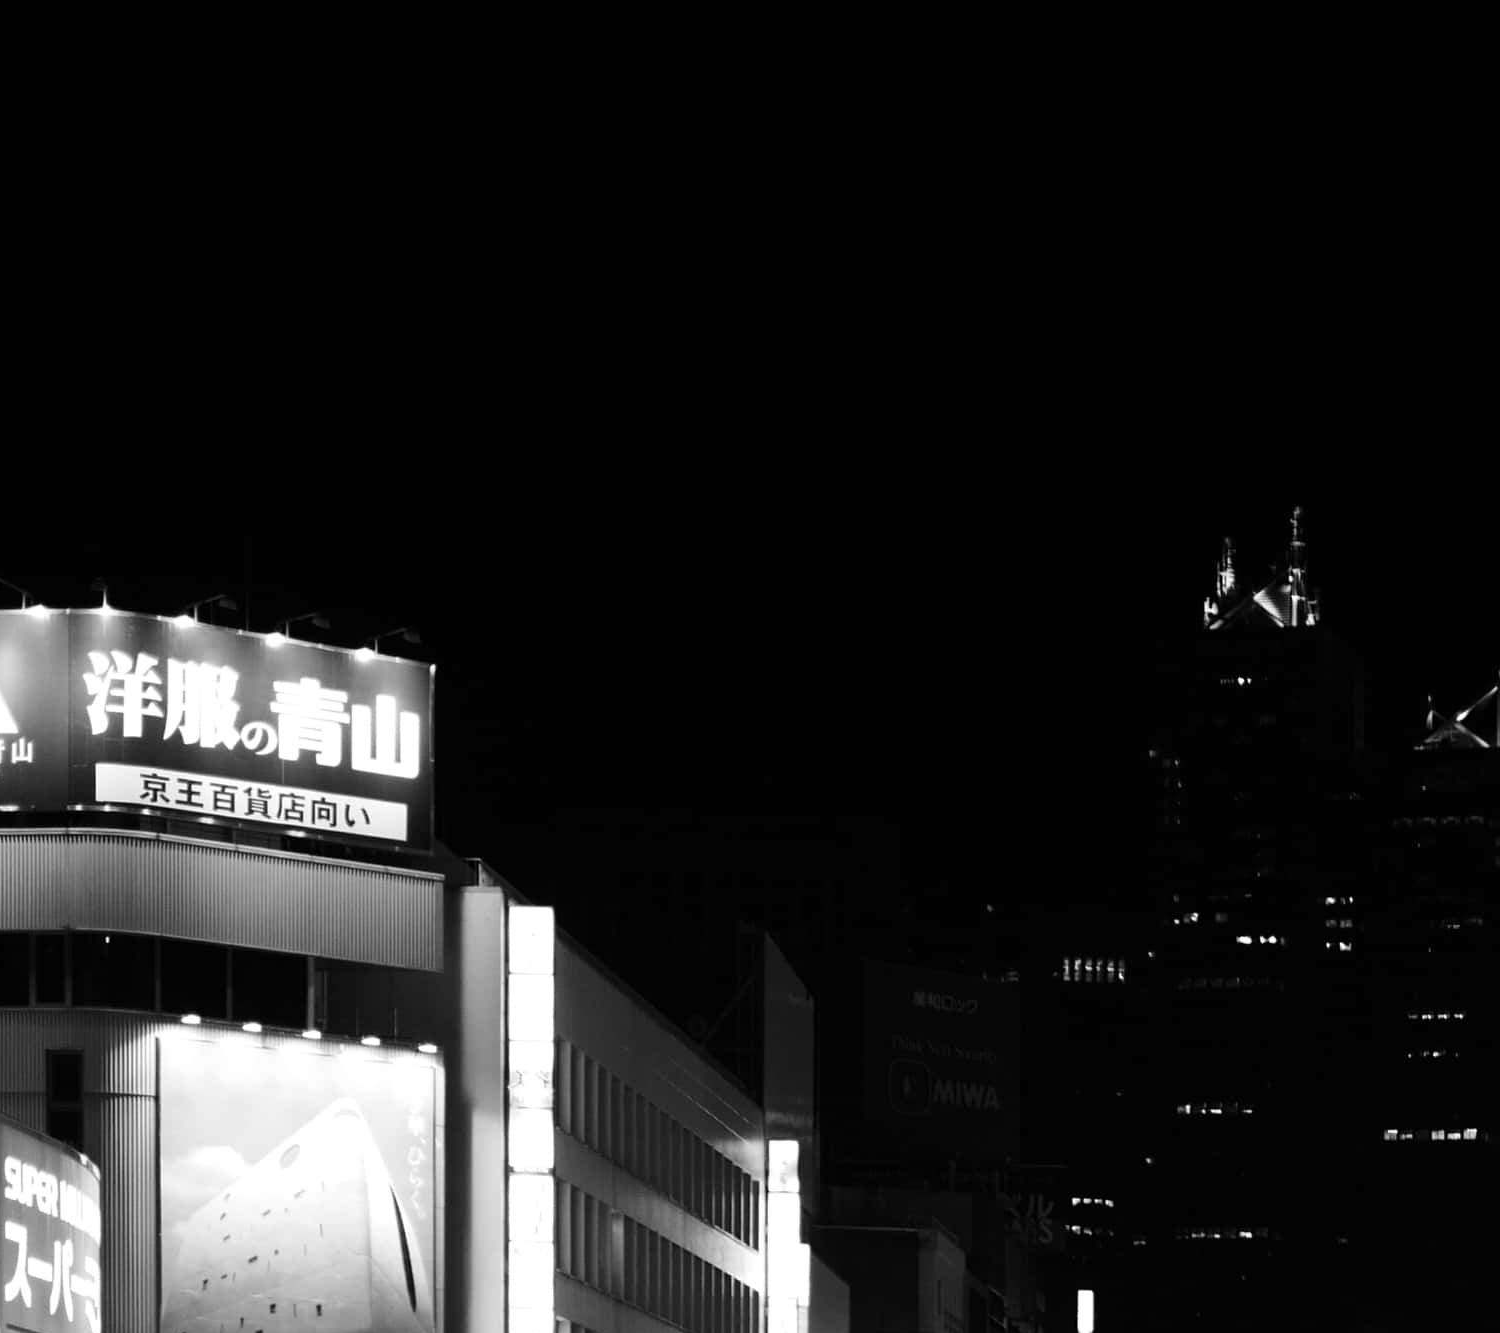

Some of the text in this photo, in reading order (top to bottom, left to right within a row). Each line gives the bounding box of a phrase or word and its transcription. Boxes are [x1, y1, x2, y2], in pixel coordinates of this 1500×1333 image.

[83, 649, 421, 780] 洋服の青山
[139, 773, 372, 828] 京王百貨店向い
